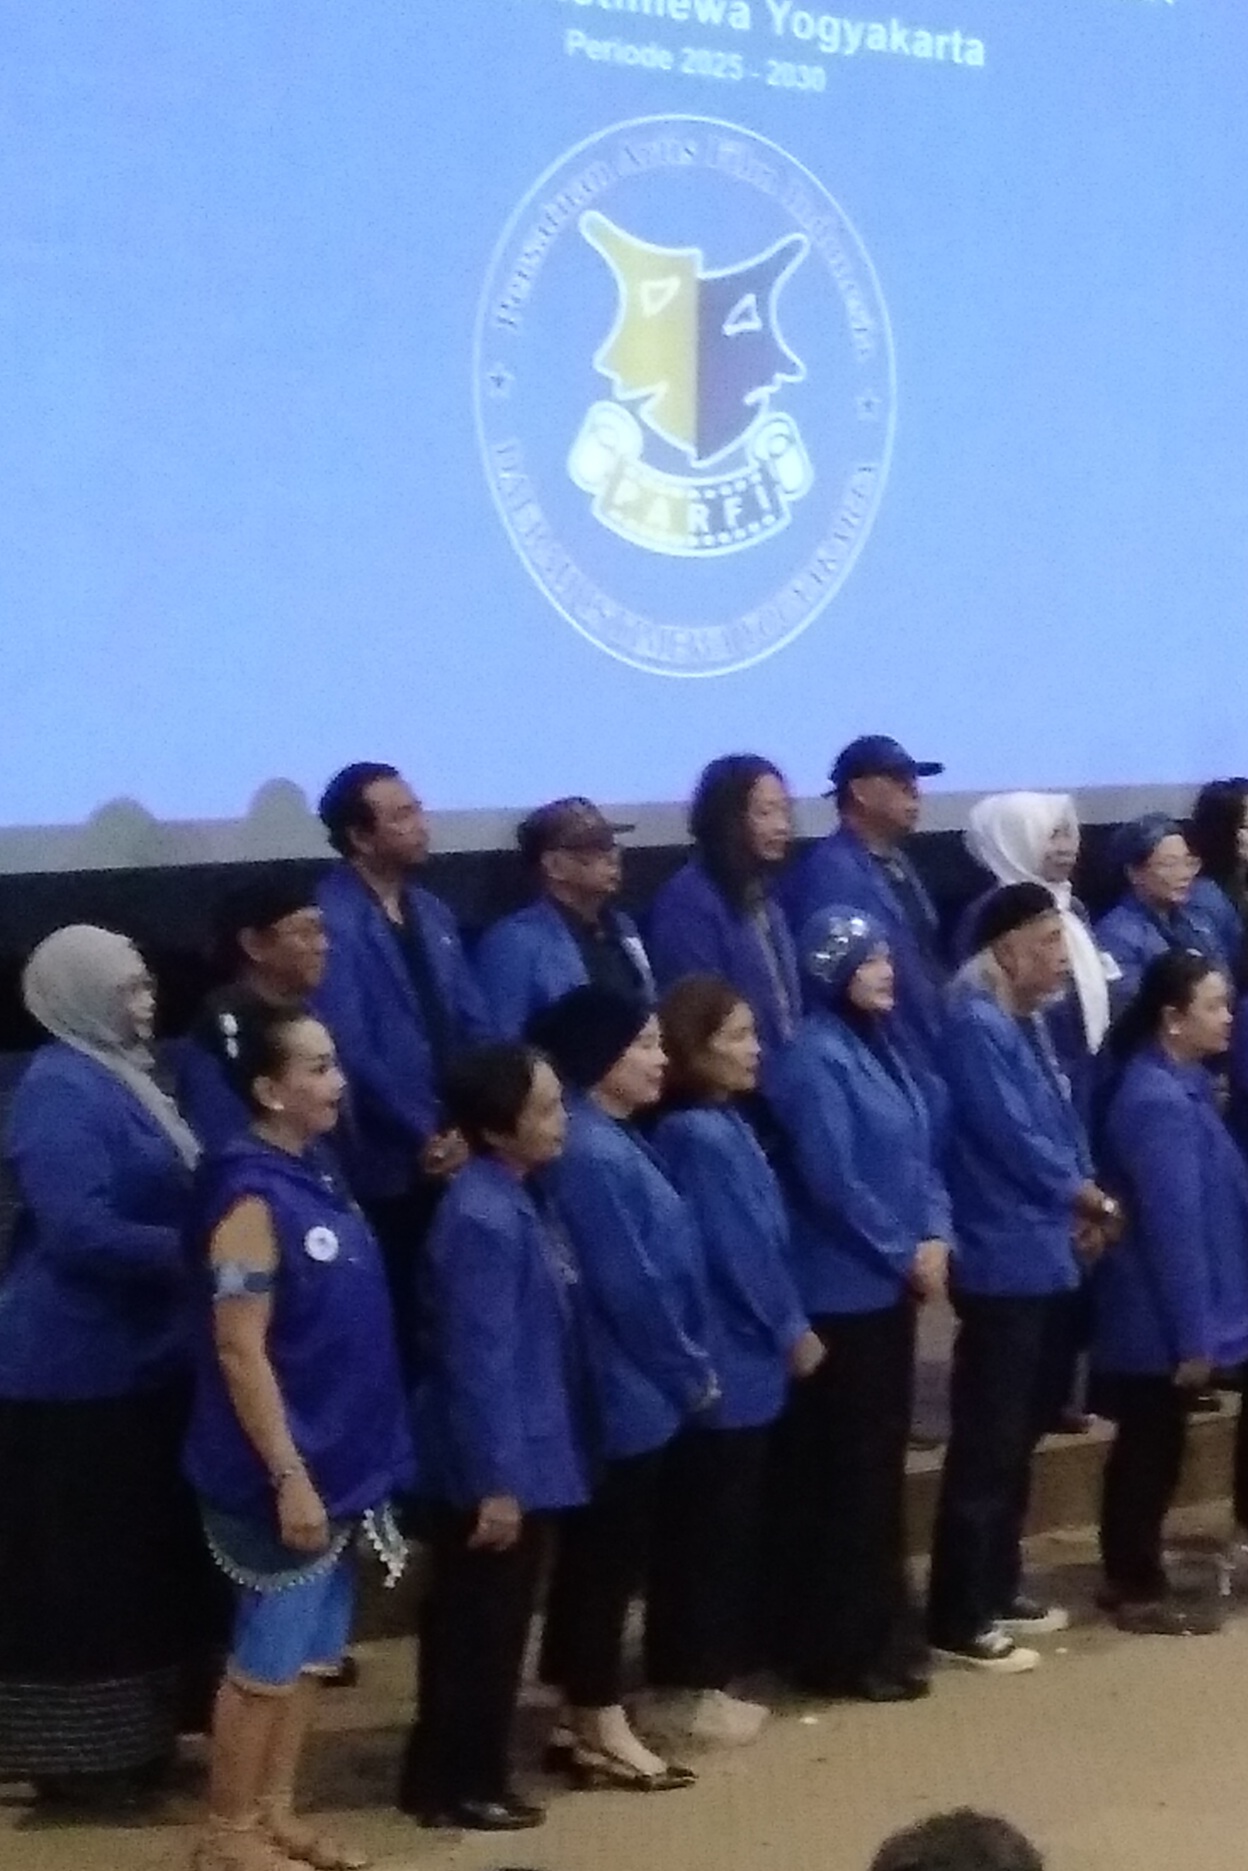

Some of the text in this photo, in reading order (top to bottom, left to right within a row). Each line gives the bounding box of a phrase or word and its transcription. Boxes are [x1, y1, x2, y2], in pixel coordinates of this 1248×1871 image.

[564, 27, 675, 71] Periode
[680, 47, 744, 82] 2025
[765, 59, 828, 93] 2030
[766, 0, 986, 67] Yogyakarta
[613, 479, 772, 533] PARFI
